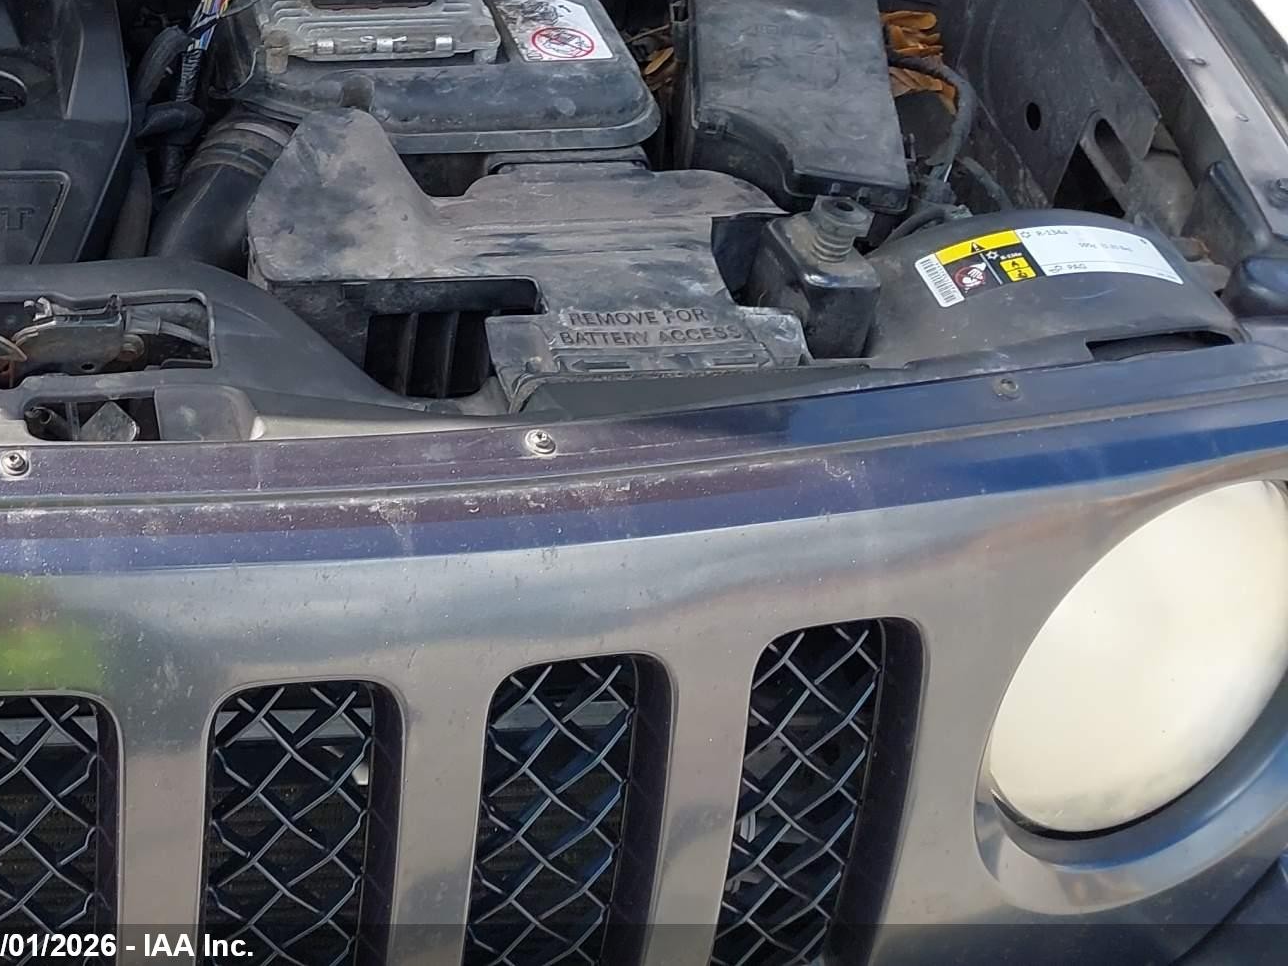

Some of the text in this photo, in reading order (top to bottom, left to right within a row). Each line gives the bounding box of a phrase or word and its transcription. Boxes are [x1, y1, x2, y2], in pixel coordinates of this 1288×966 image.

[567, 307, 709, 326] REMOVE FOR
[559, 324, 742, 346] BATTERY ACCESS
